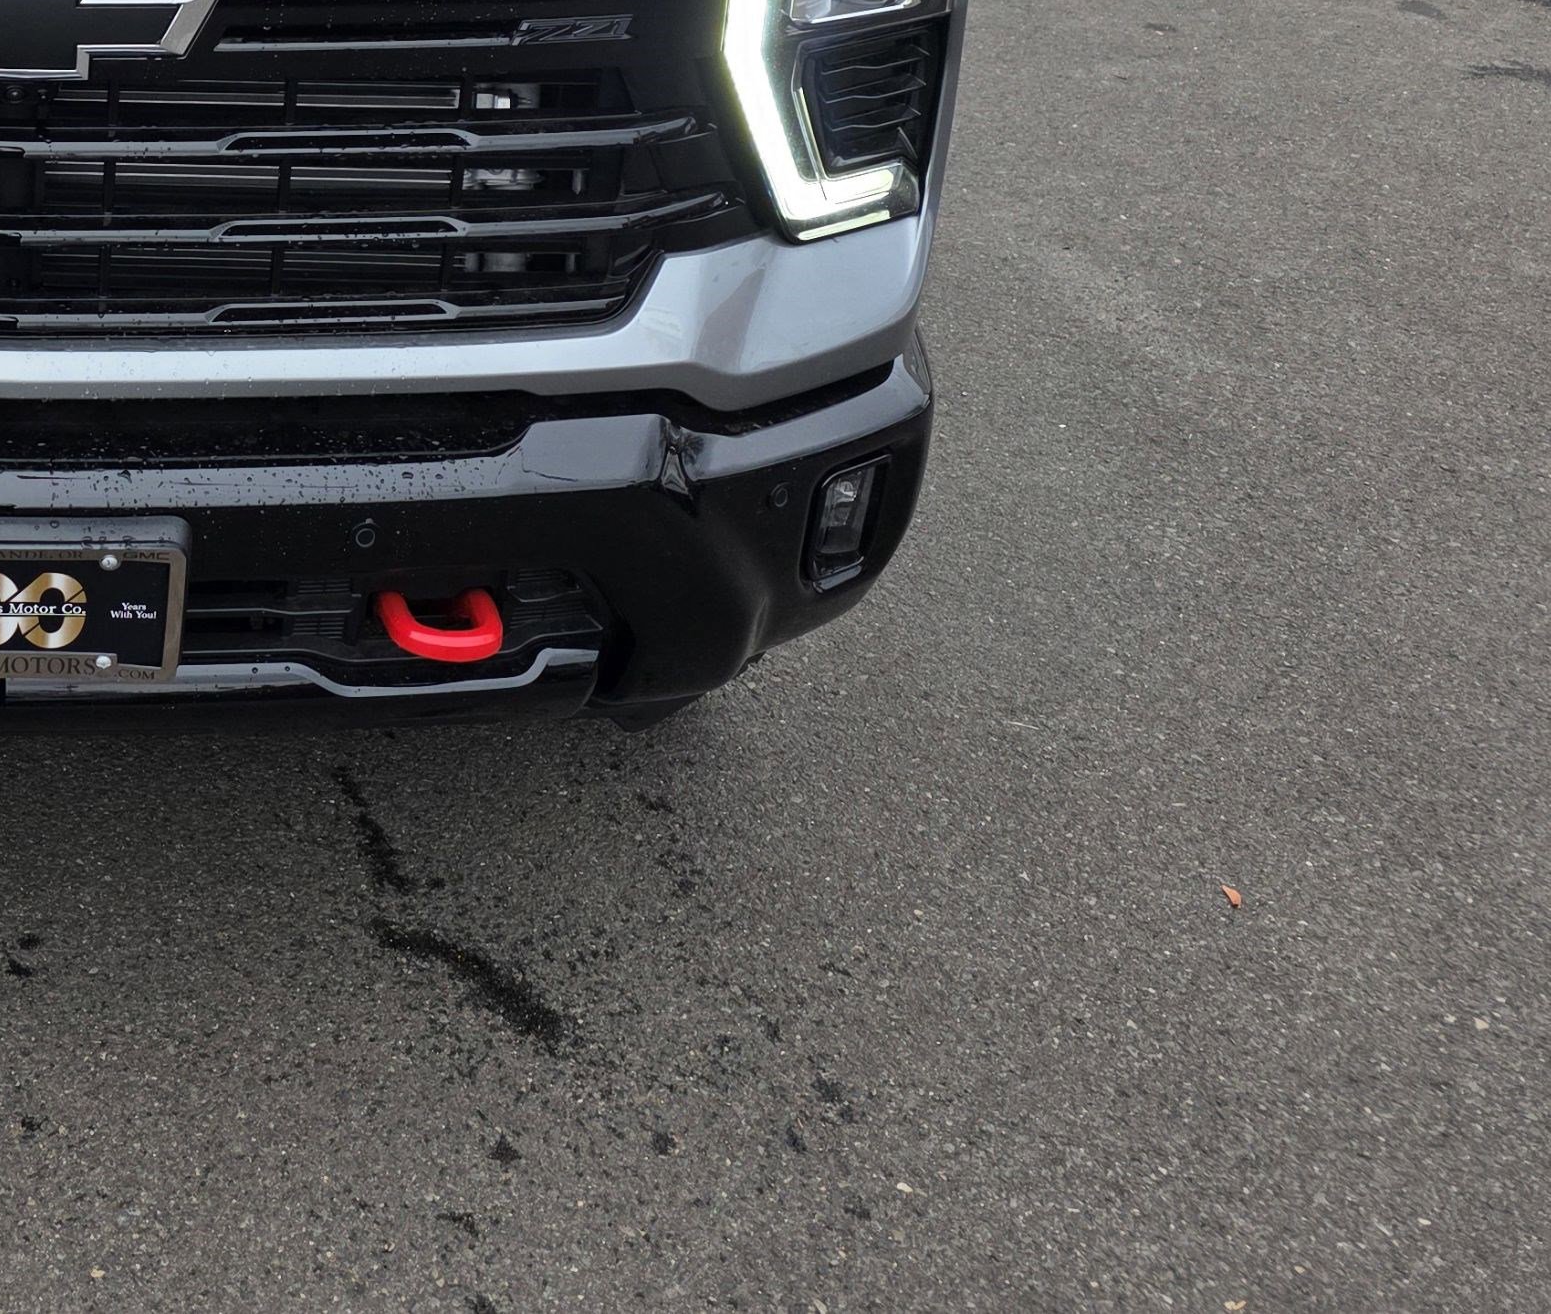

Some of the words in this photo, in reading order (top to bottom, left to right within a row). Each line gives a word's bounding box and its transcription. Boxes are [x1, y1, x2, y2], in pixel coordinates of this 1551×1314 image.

[59, 550, 83, 559] OR
[122, 551, 170, 561] GMC
[9, 602, 57, 615] Motor
[61, 603, 87, 615] Co.
[121, 602, 147, 611] Years
[110, 610, 134, 619] With
[135, 610, 157, 619] You!
